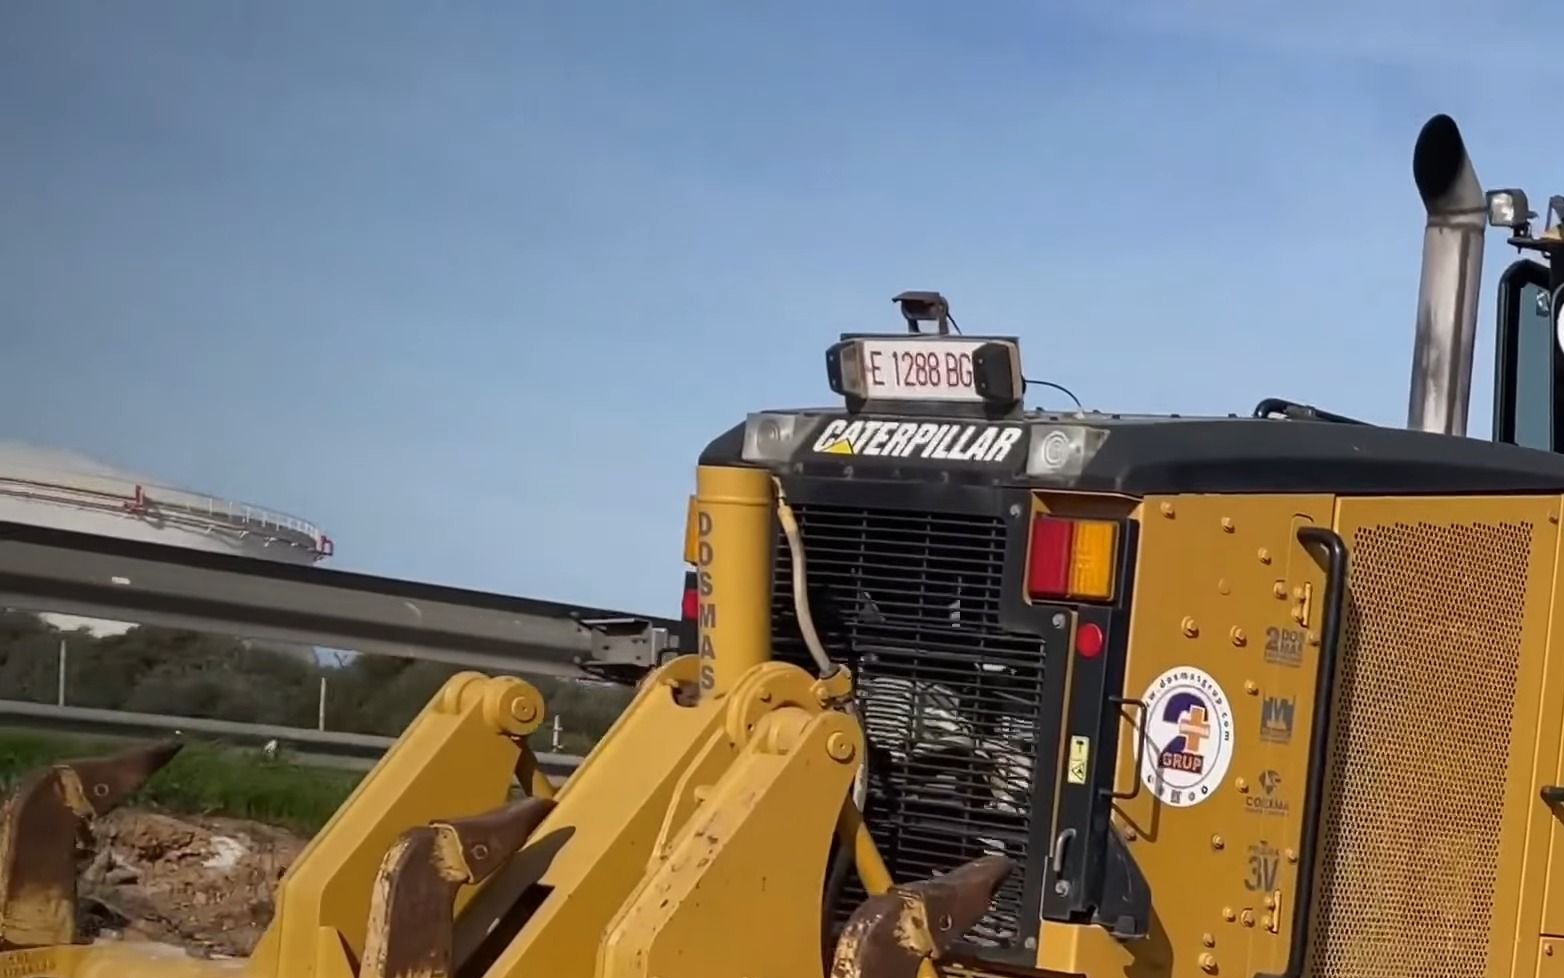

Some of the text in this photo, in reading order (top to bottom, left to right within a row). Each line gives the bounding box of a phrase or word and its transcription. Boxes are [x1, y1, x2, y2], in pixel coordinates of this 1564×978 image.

[869, 350, 885, 387] E
[892, 350, 942, 387] 1288
[812, 418, 1023, 463] CATERPILLAR
[1161, 751, 1203, 772] GRUP
